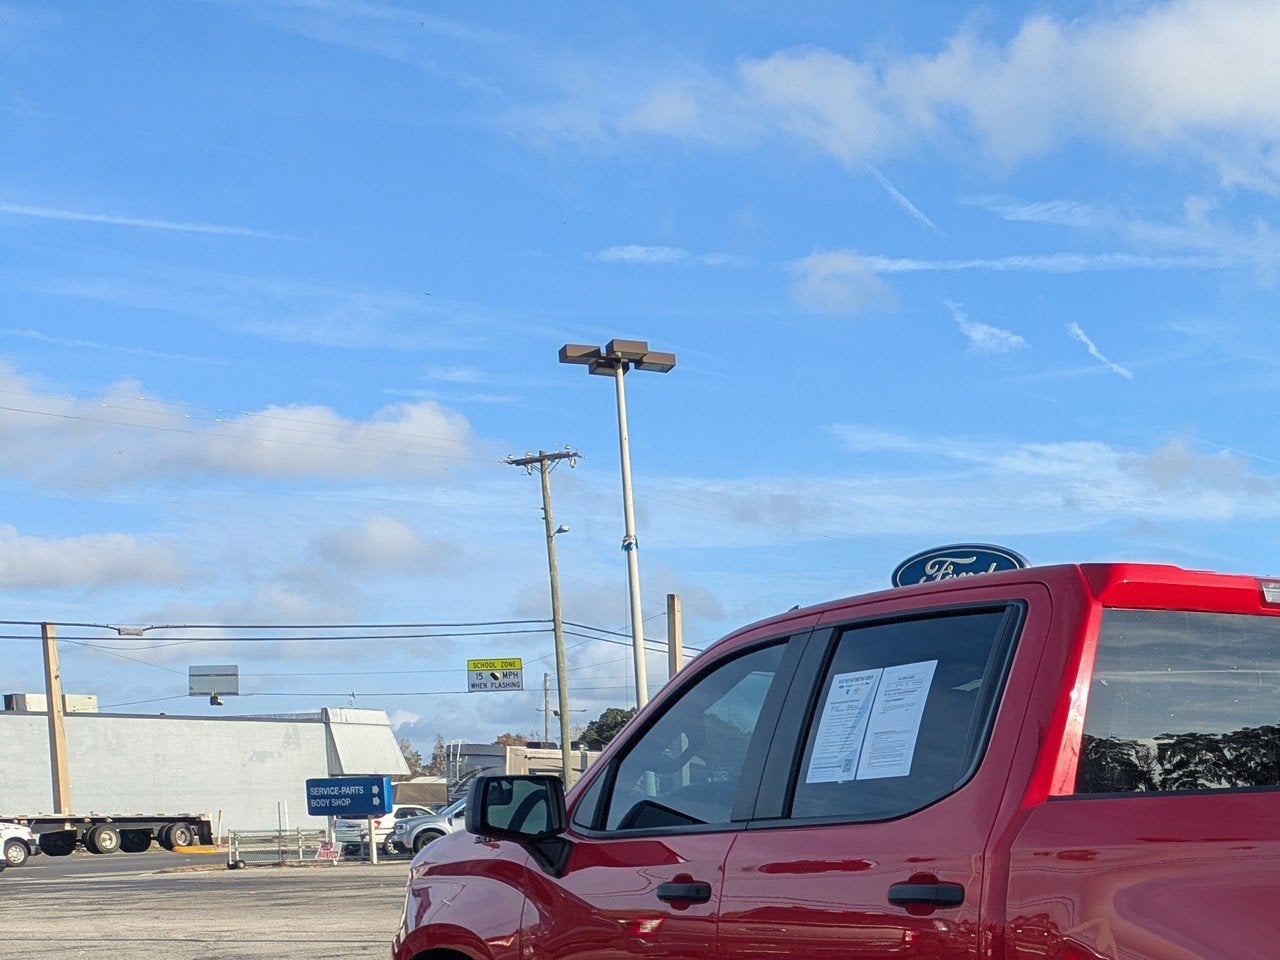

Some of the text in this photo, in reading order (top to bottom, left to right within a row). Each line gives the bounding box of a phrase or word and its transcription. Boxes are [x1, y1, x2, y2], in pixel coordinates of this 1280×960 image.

[472, 660, 517, 669] SCHOOL ZONE
[475, 671, 519, 681] 15 MPH
[490, 681, 521, 689] FLASHING
[310, 786, 364, 796] SERVICE-PARTS
[311, 798, 351, 807] BODY SHOP
